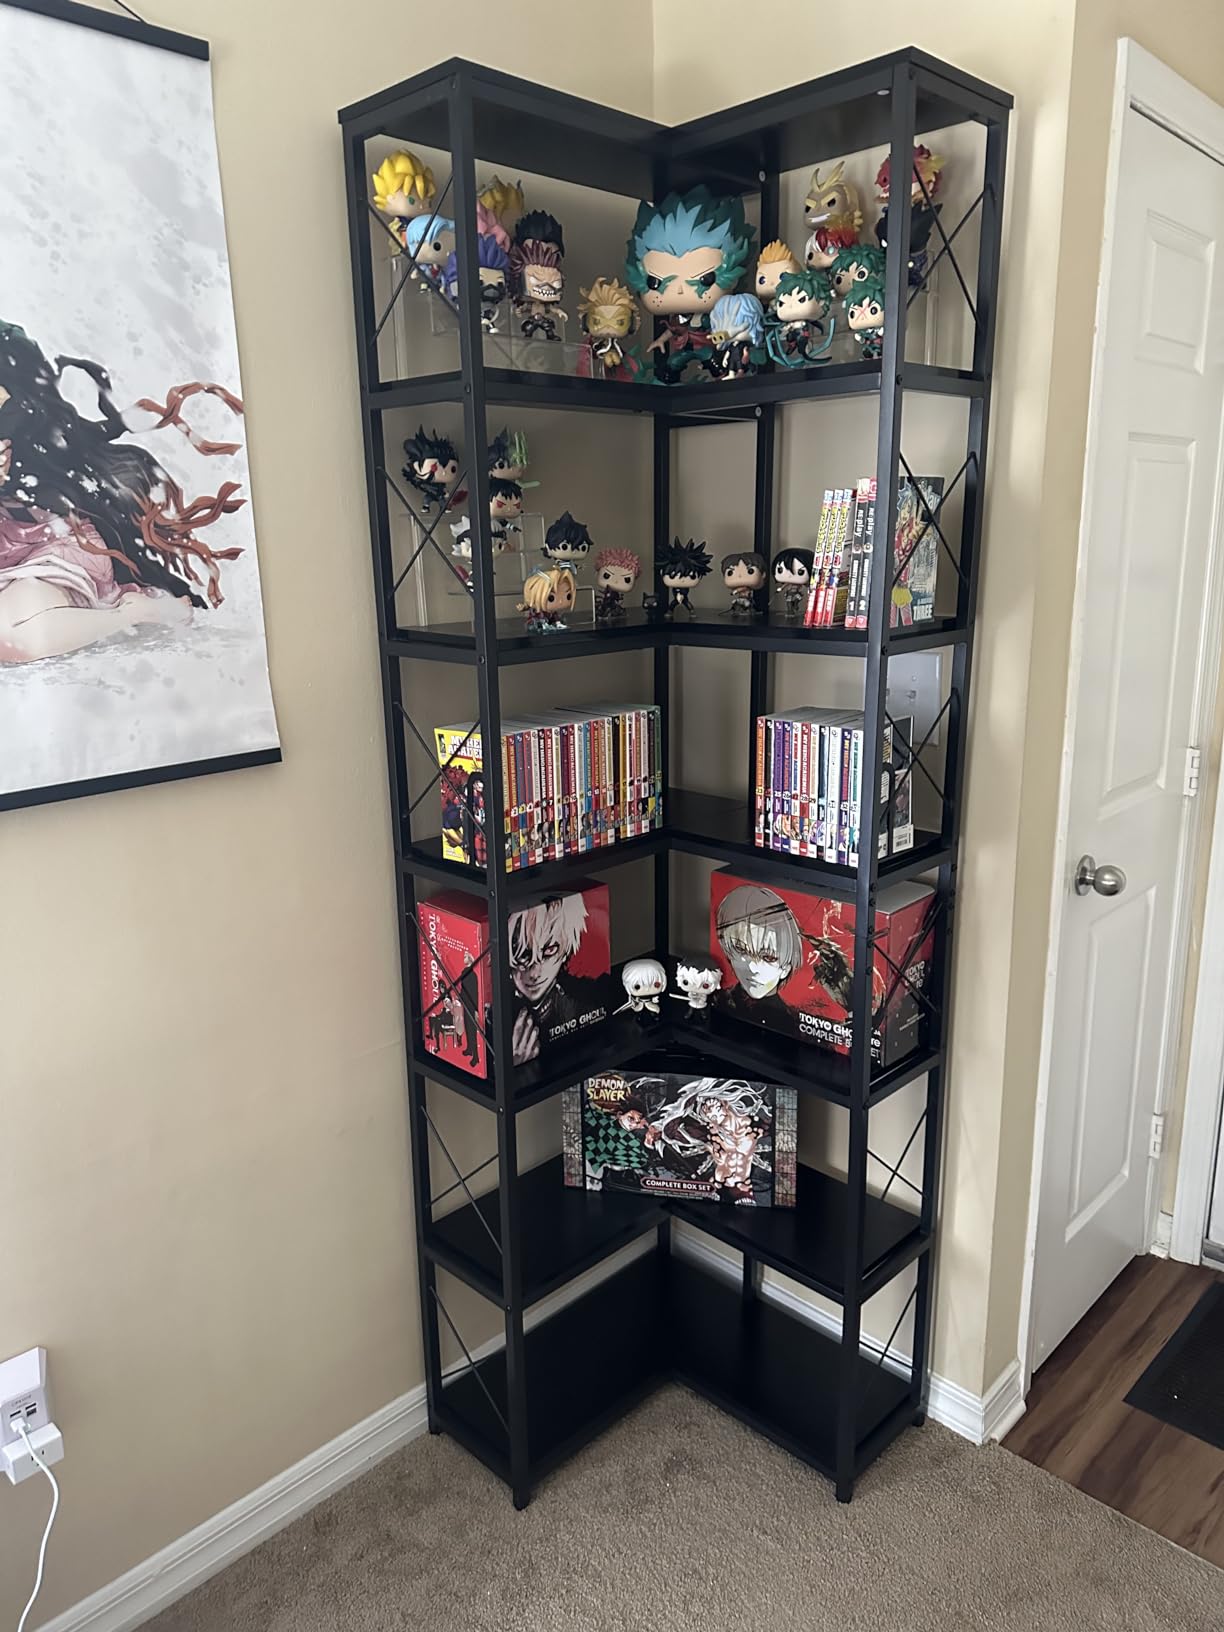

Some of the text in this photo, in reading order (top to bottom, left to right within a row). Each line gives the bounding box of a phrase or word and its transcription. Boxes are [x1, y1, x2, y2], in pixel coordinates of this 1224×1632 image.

[849, 601, 855, 611] 1
[859, 600, 866, 610] 2
[913, 604, 933, 621] THREE
[549, 1019, 577, 1037] TOKYO
[579, 1007, 607, 1024] GHOUL
[799, 1012, 832, 1031] TOKYO
[799, 1023, 843, 1046] COMPLETE
[588, 1078, 625, 1090] DEMON
[587, 1088, 626, 1102] SLAYER
[645, 1180, 681, 1189] COMPLETE
